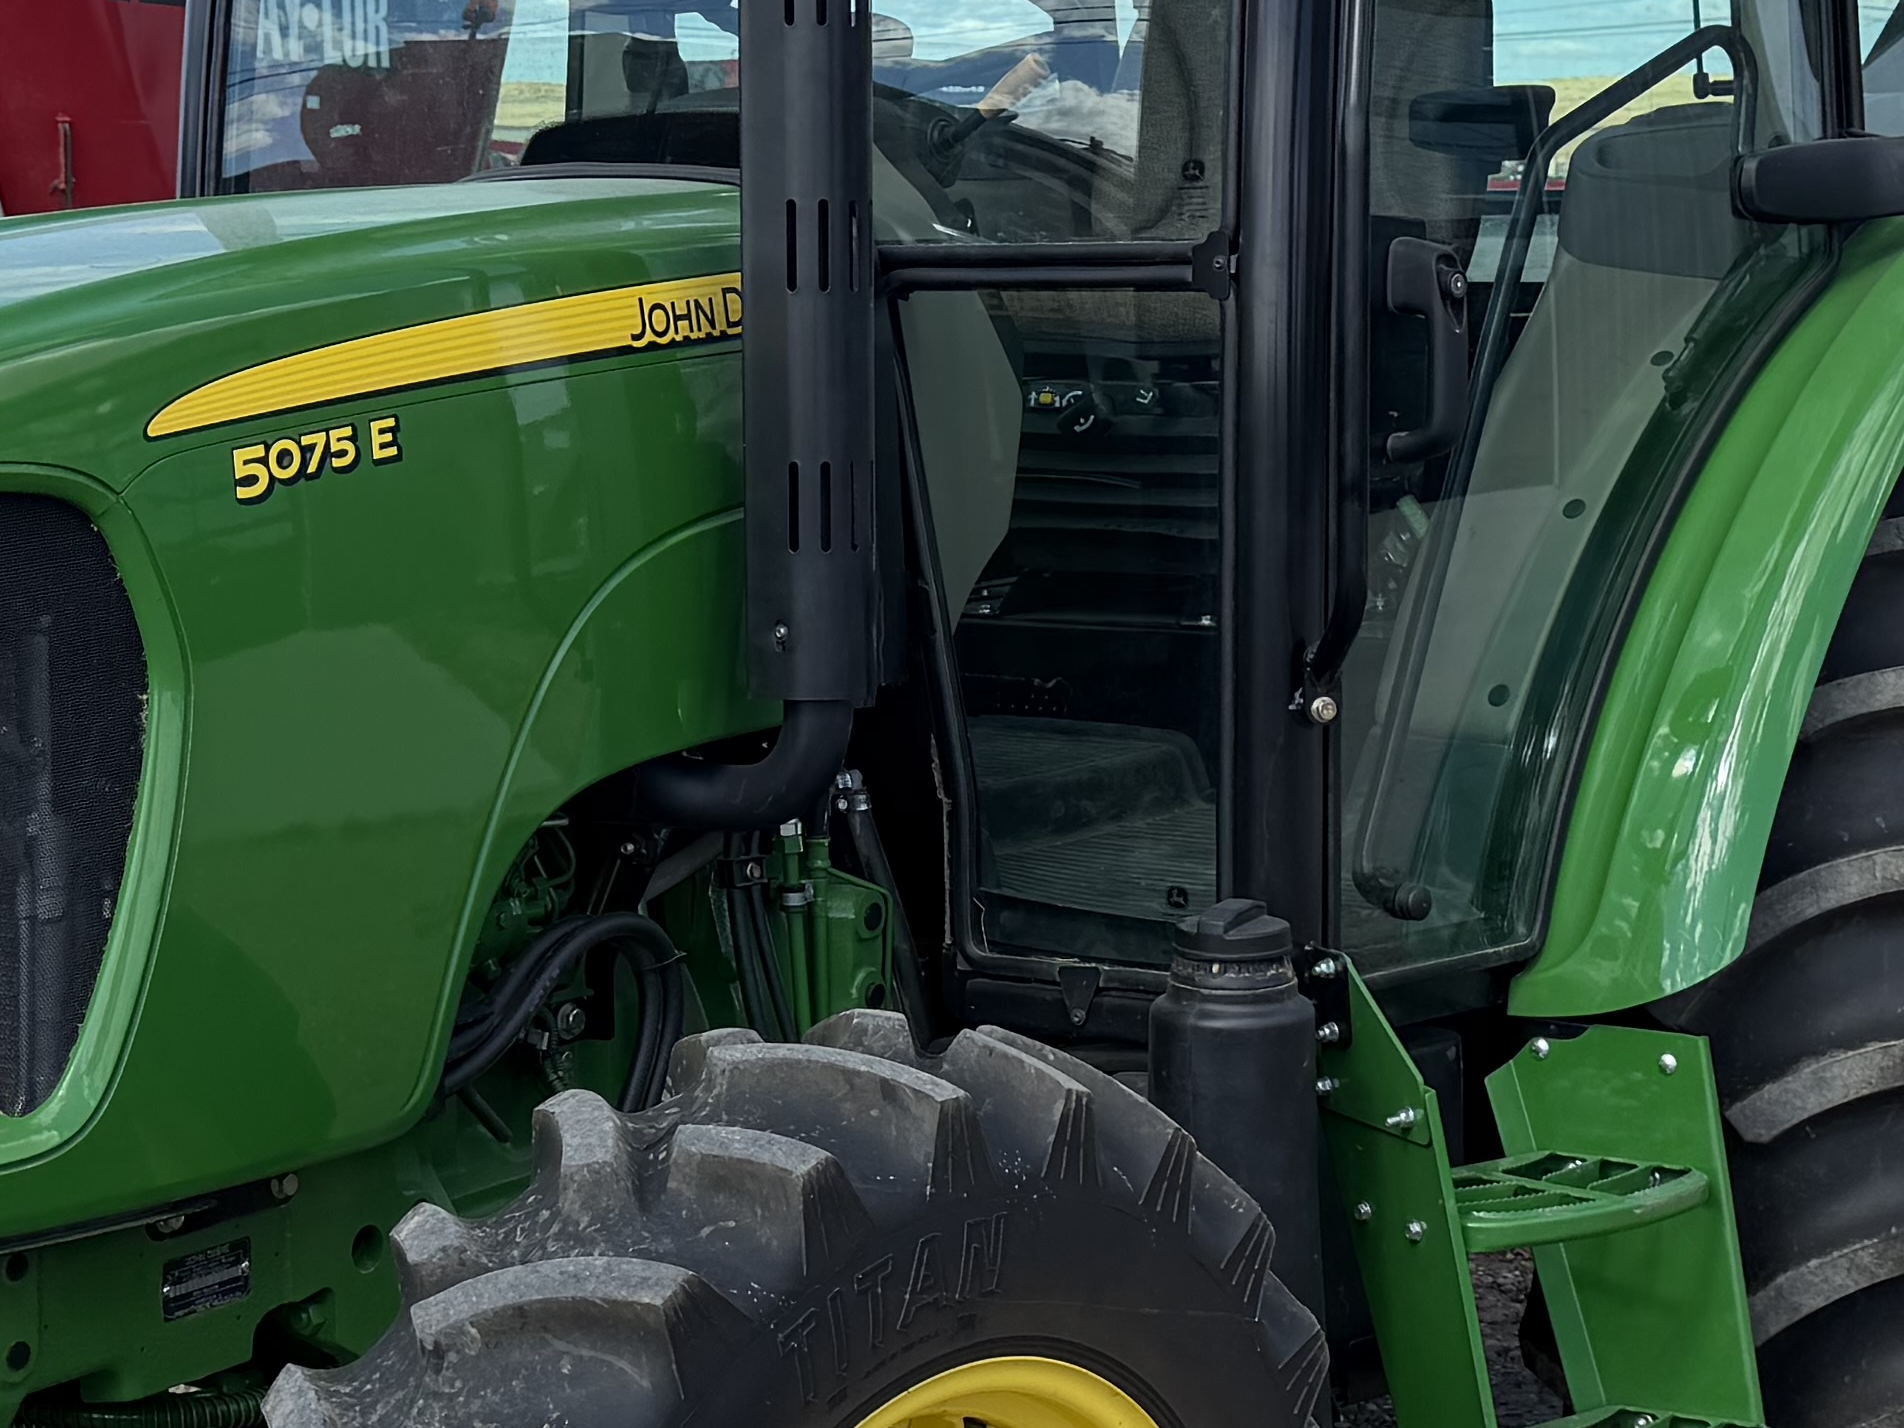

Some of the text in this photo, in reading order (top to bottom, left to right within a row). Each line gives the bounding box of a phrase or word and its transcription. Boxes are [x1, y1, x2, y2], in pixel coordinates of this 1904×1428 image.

[630, 296, 718, 342] JOHN
[232, 416, 401, 504] 5075 E
[776, 1211, 1010, 1407] TITAN
